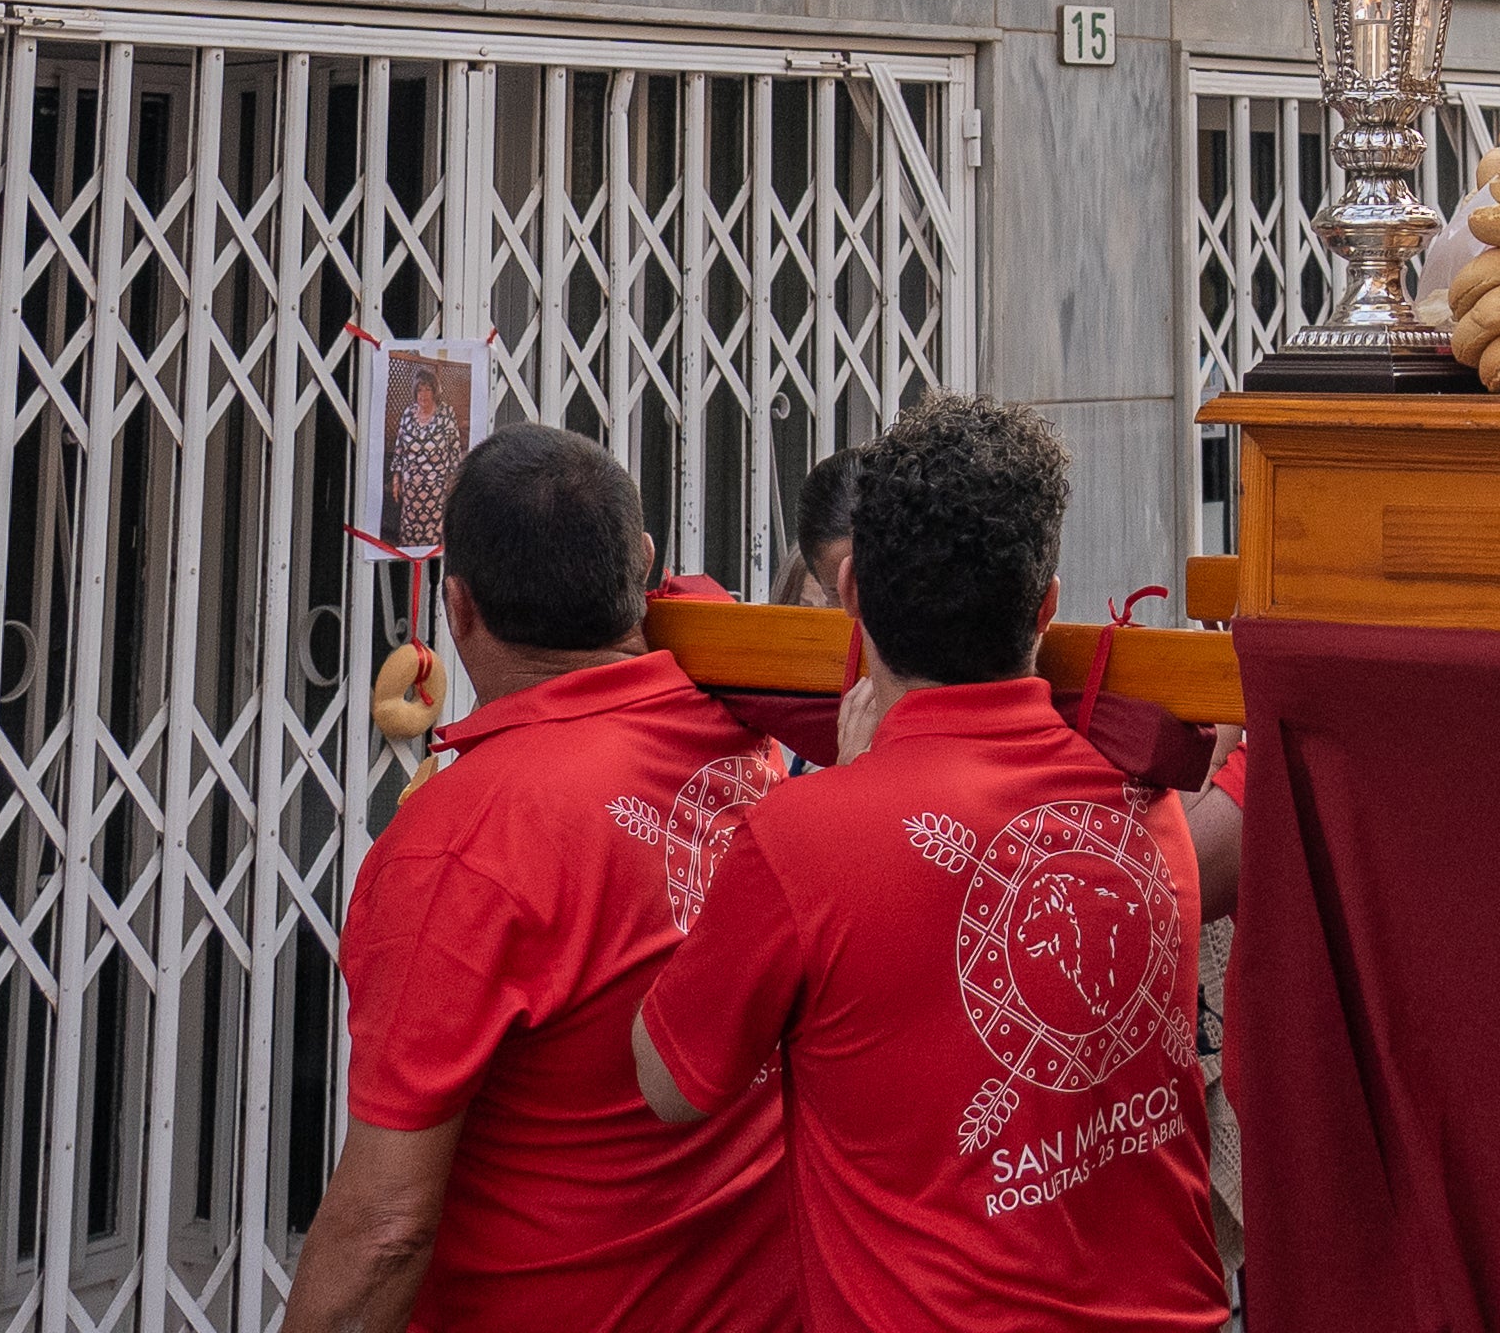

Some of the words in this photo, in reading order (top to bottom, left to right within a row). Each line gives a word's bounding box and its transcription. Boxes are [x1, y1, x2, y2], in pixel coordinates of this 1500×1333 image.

[1071, 10, 1107, 61] 15
[985, 1158, 1090, 1217] ROQUETAS
[1098, 1138, 1115, 1168] 25
[1120, 1131, 1149, 1155] DE
[1152, 1113, 1187, 1150] ABRIL
[992, 1130, 1063, 1183] SAN
[1075, 1077, 1180, 1158] MARCOS
